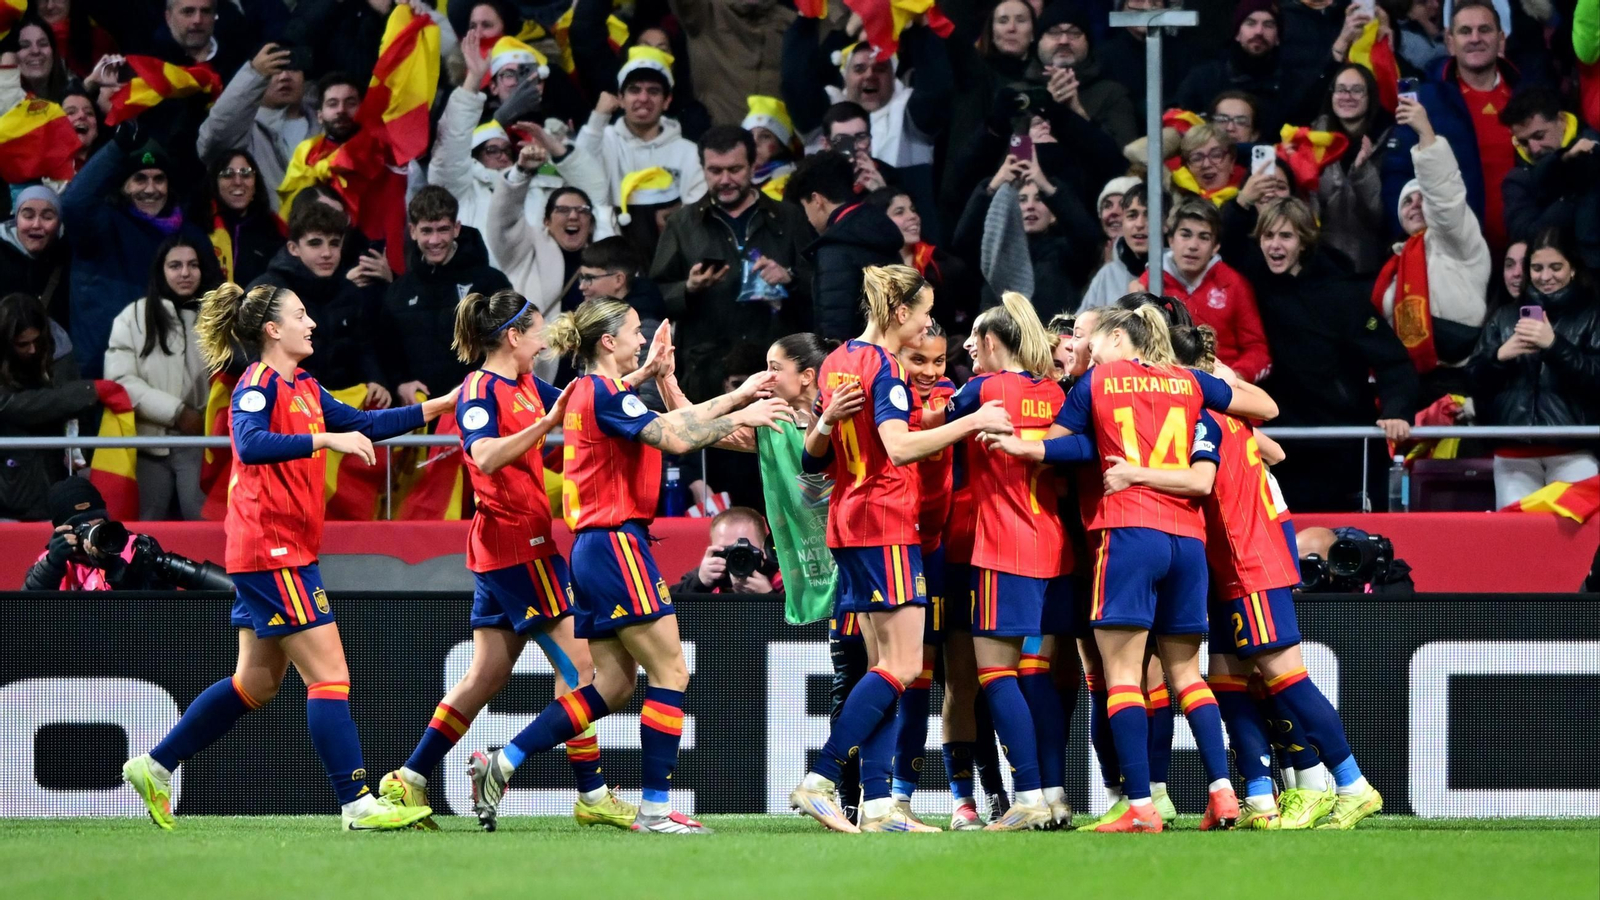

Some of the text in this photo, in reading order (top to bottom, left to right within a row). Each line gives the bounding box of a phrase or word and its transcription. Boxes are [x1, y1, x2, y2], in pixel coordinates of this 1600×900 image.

[1103, 376, 1194, 396] ALEIXANDRI
[1021, 398, 1054, 420] OLGA
[1113, 406, 1191, 469] 14
[1231, 612, 1249, 648] 2
